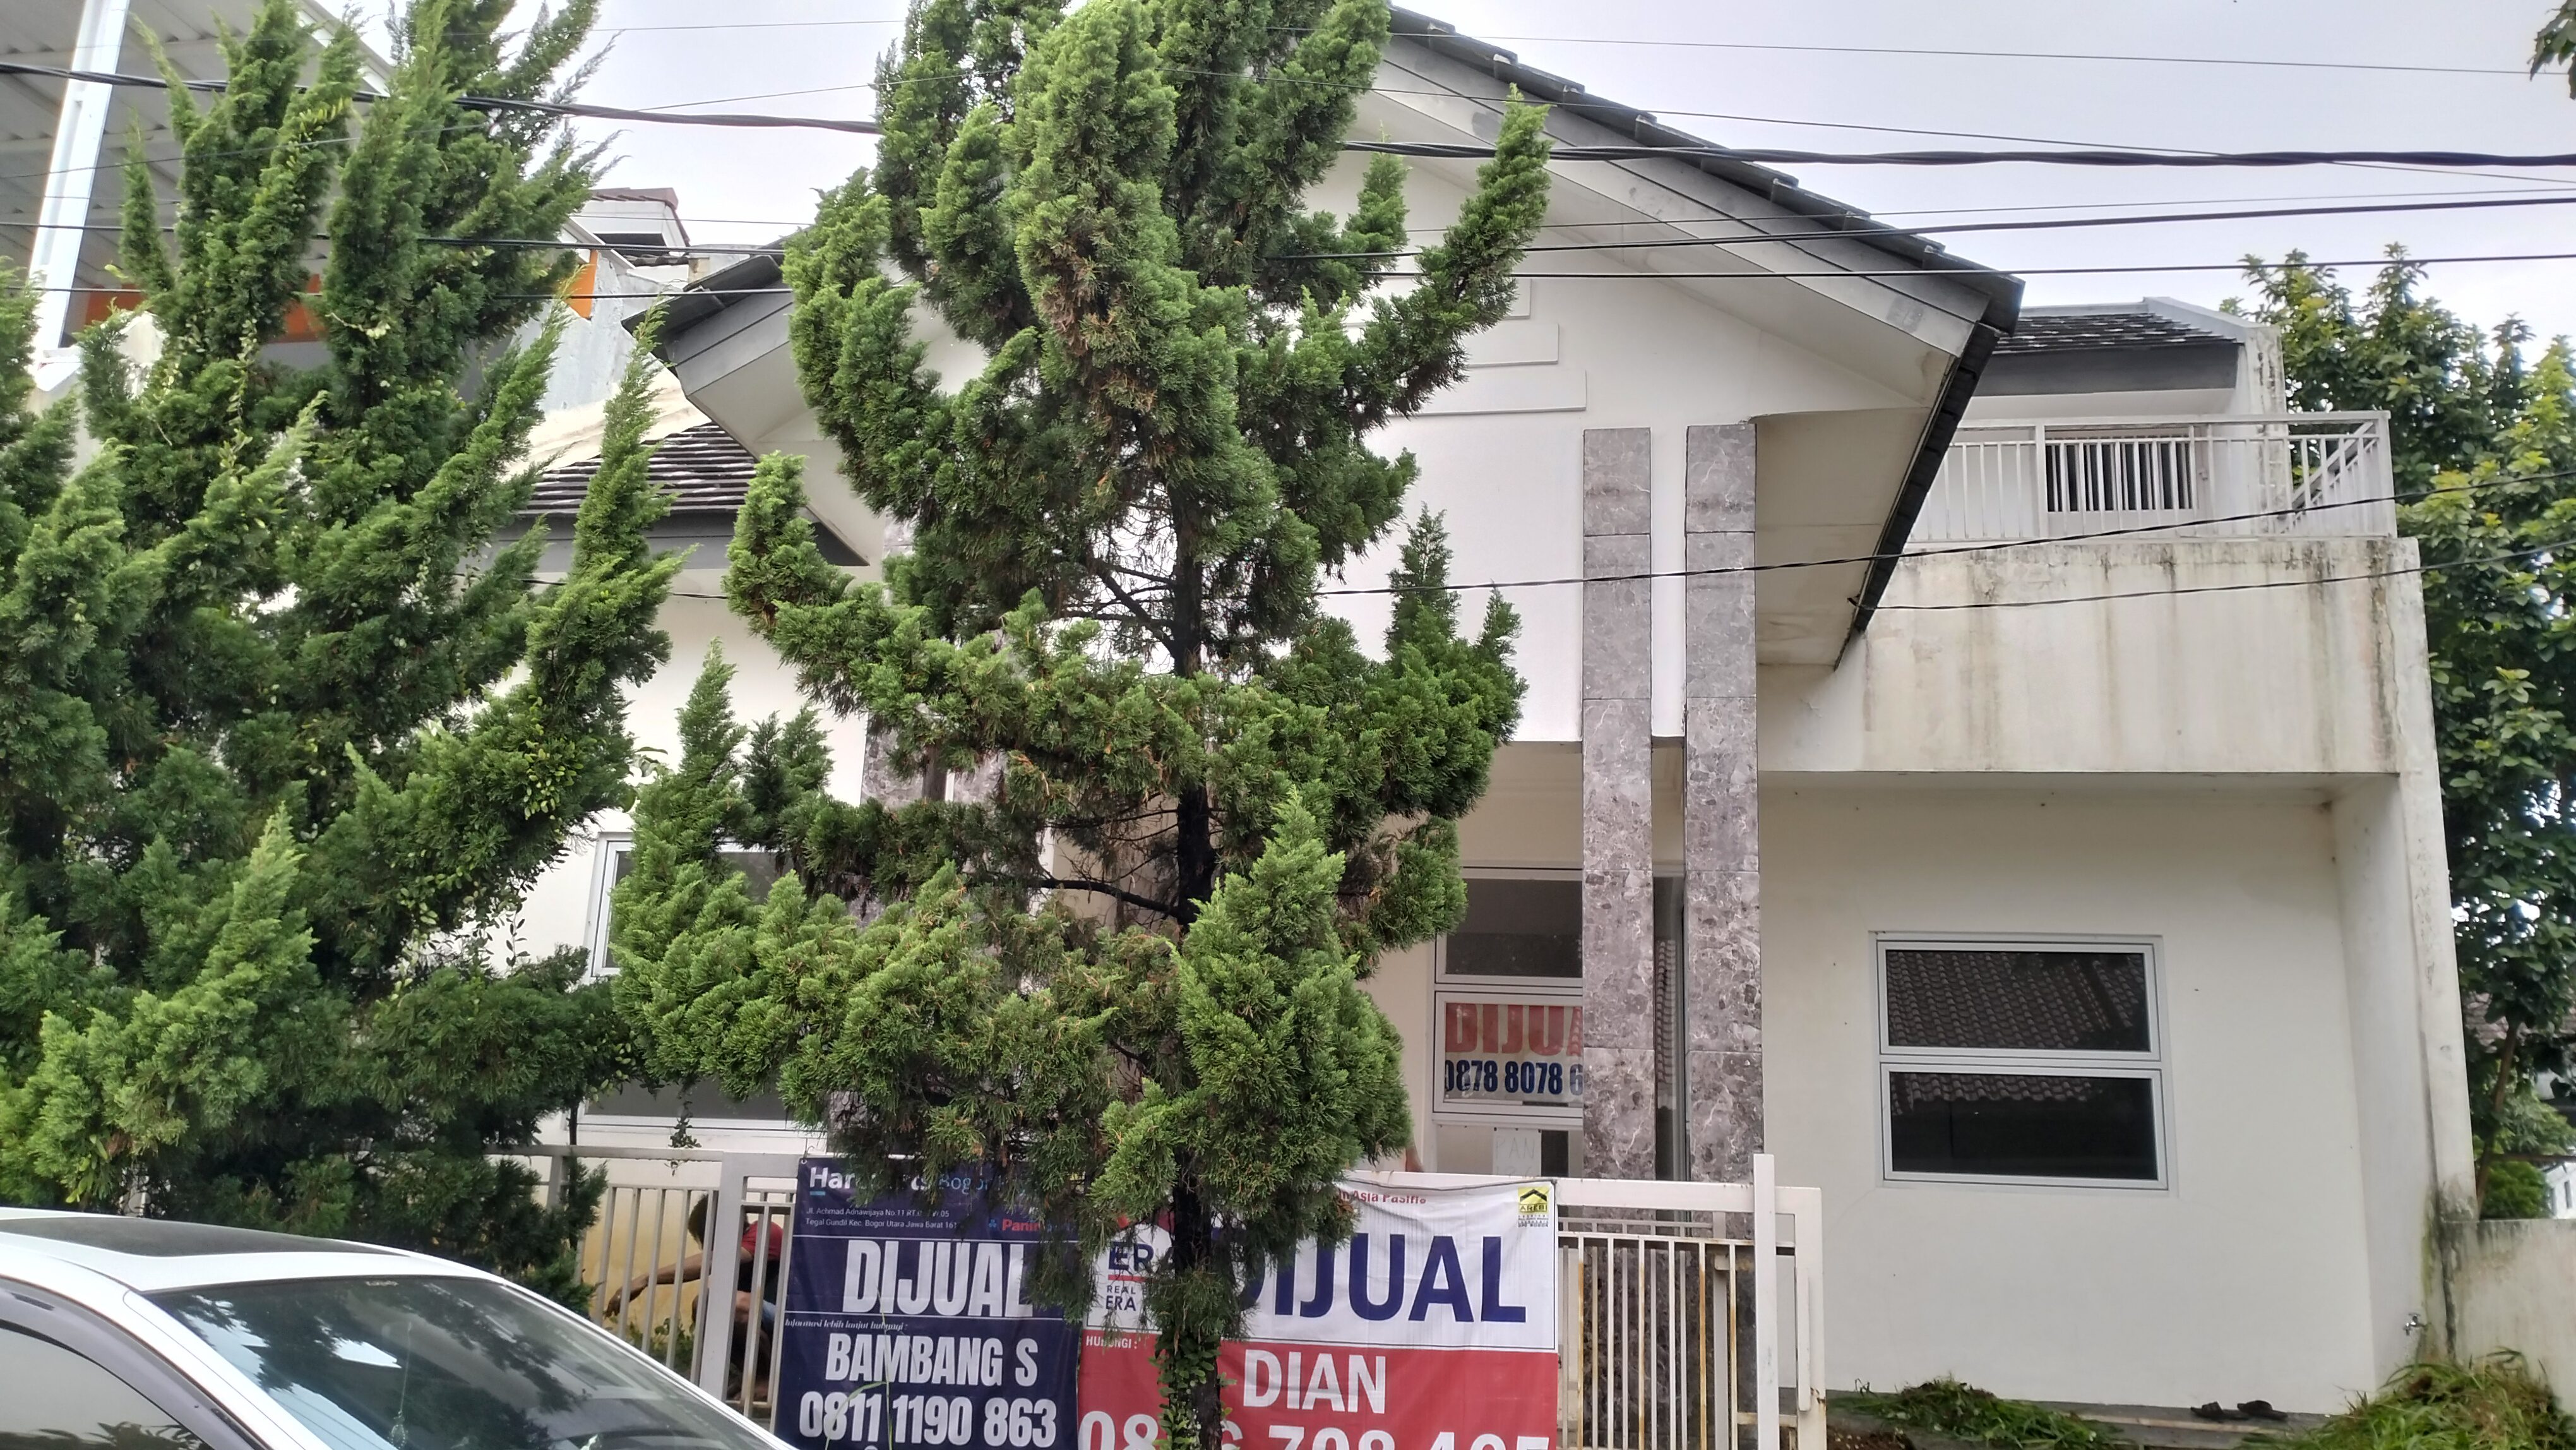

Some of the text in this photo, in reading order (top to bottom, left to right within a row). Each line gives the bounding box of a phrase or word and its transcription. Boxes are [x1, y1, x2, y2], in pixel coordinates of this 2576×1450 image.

[1445, 1060, 1498, 1092] 0878
[1505, 1061, 1563, 1095] 8078
[806, 1218, 825, 1227] Tegal
[865, 1219, 885, 1228] Bogor
[816, 1207, 845, 1215] Achmad
[1108, 1240, 1155, 1273] ER
[842, 1239, 1034, 1317] DIJUAL
[1107, 1285, 1137, 1295] REAL
[1212, 1227, 1527, 1322] IJUAL
[1106, 1295, 1137, 1312] ERA
[825, 1333, 1039, 1387] BAMBANG S
[1243, 1349, 1386, 1414] DIAN
[799, 1391, 1057, 1448] 0811 1190 863
